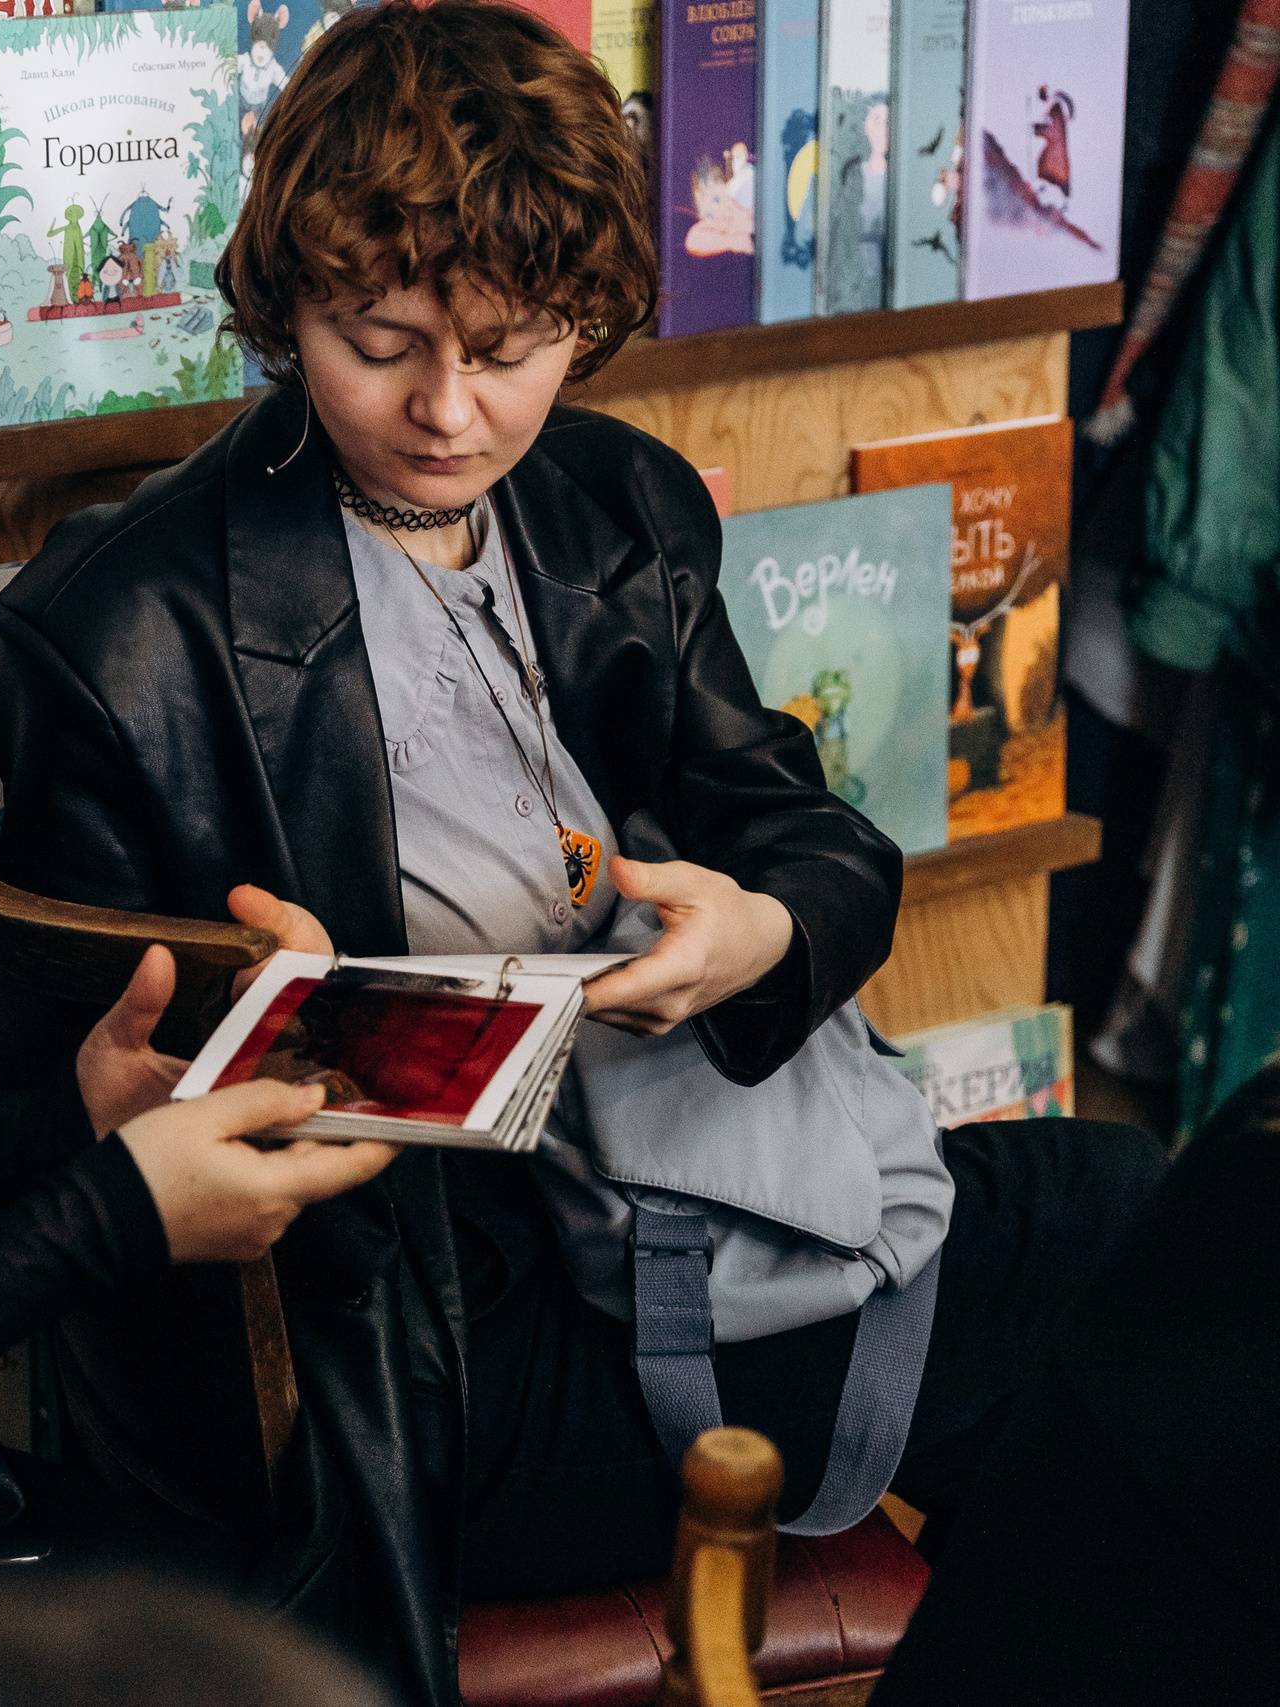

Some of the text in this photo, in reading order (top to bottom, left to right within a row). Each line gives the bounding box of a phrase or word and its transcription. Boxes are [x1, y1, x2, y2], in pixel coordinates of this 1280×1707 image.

[20, 68, 75, 80] Давид Кали
[132, 60, 206, 73] Себастьян Мурен
[43, 93, 176, 123] Школа рисования
[42, 136, 179, 176] Горошка
[749, 547, 898, 637] Верлен
